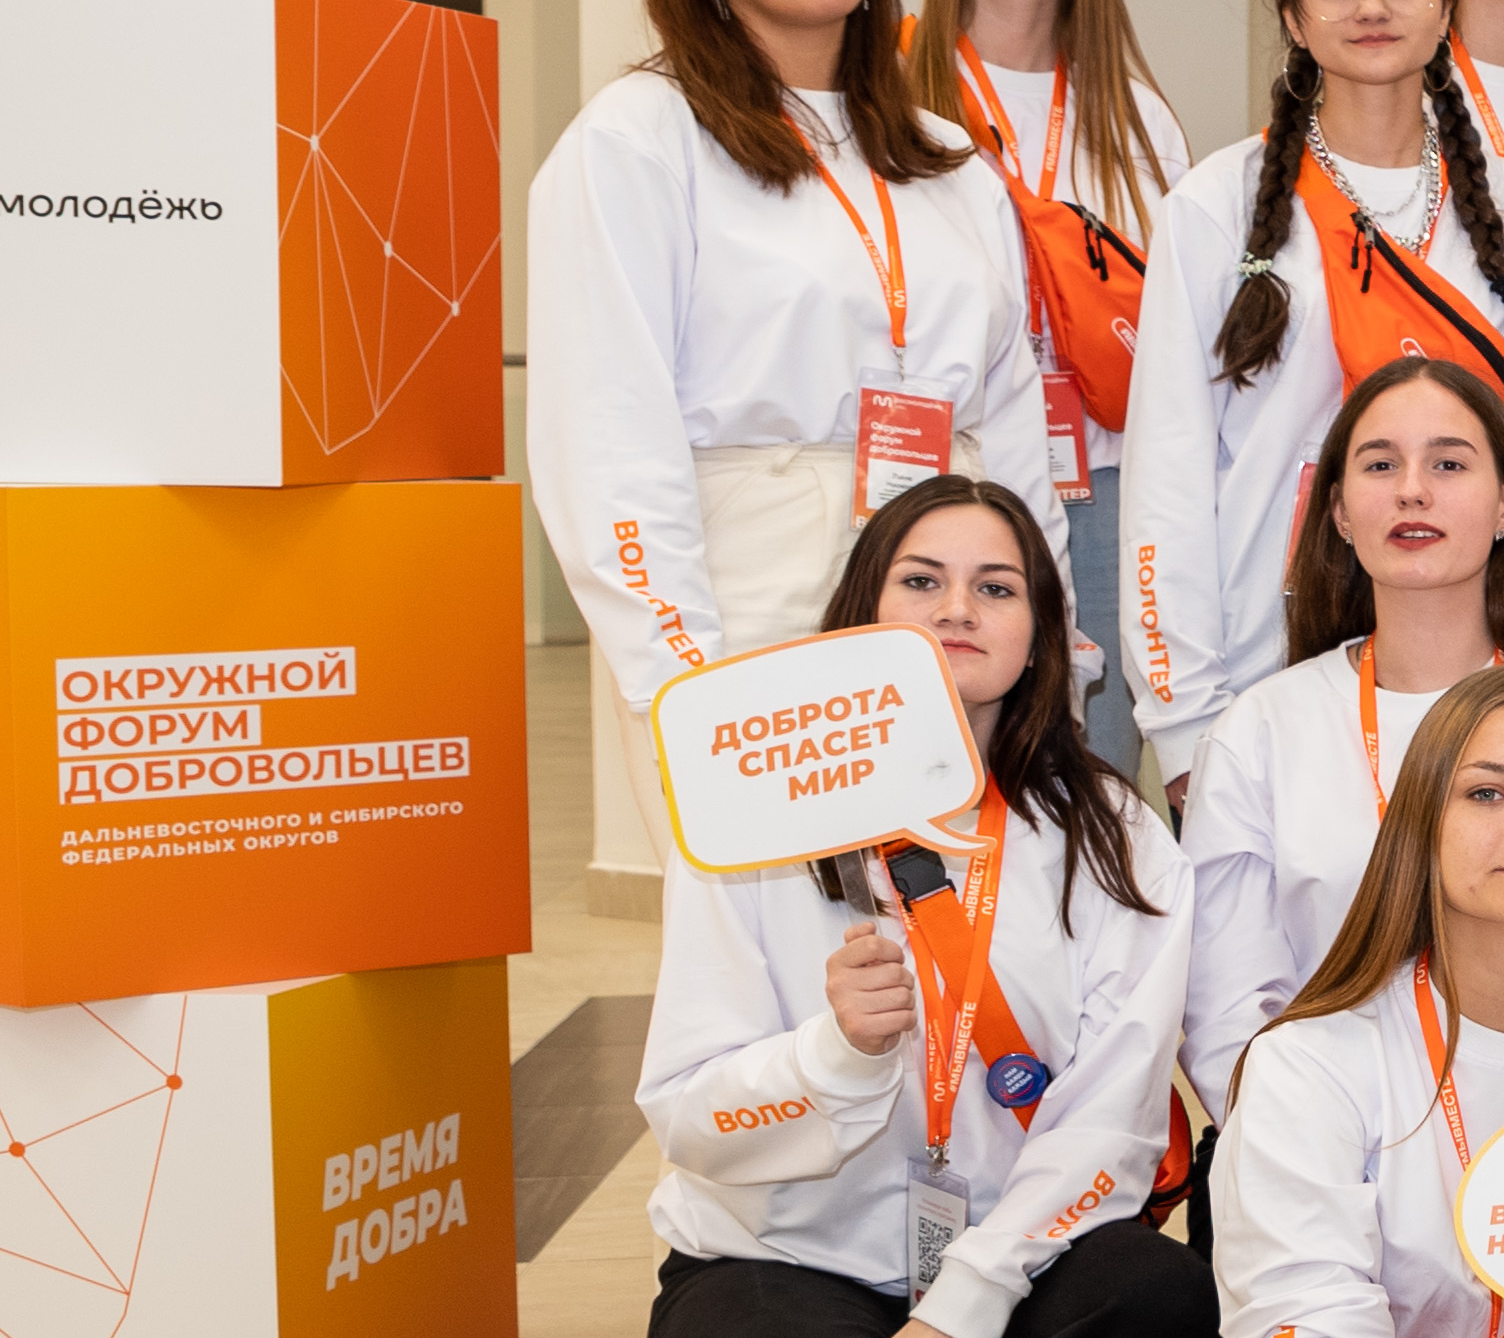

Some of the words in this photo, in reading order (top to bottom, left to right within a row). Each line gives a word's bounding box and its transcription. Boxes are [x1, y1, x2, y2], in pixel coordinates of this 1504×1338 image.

[613, 518, 705, 669] ВОЛНТЕР
[1136, 543, 1174, 704] ВОЛОНТЕР
[61, 651, 350, 703] ОКРУЖНОЙ
[62, 710, 250, 752] ФОРУМ
[710, 682, 905, 757] ДОБРОТА
[736, 718, 896, 779] СПАСЕТ
[62, 741, 467, 805] ДОБРОВОЛЬЦЕВ
[786, 757, 876, 803] МИР
[61, 811, 303, 848] ДАЛЬНЕВОСТОЧНОГО
[308, 810, 325, 826] И
[330, 800, 465, 825] СИБИРСКОГО
[61, 838, 237, 866] ФЕДЕРАЛЬНЫХ
[243, 829, 340, 851] ОКРУГОВ
[965, 852, 988, 926] ЫВМЕСТЕ
[950, 1001, 977, 1093] #МЫВМЕСТЕ
[712, 1096, 815, 1134] ВОЛО
[1439, 1075, 1472, 1167] МЫВМЕСТЕ
[321, 1111, 462, 1212] ВРЕМЯ
[325, 1179, 468, 1291] ДОБРА
